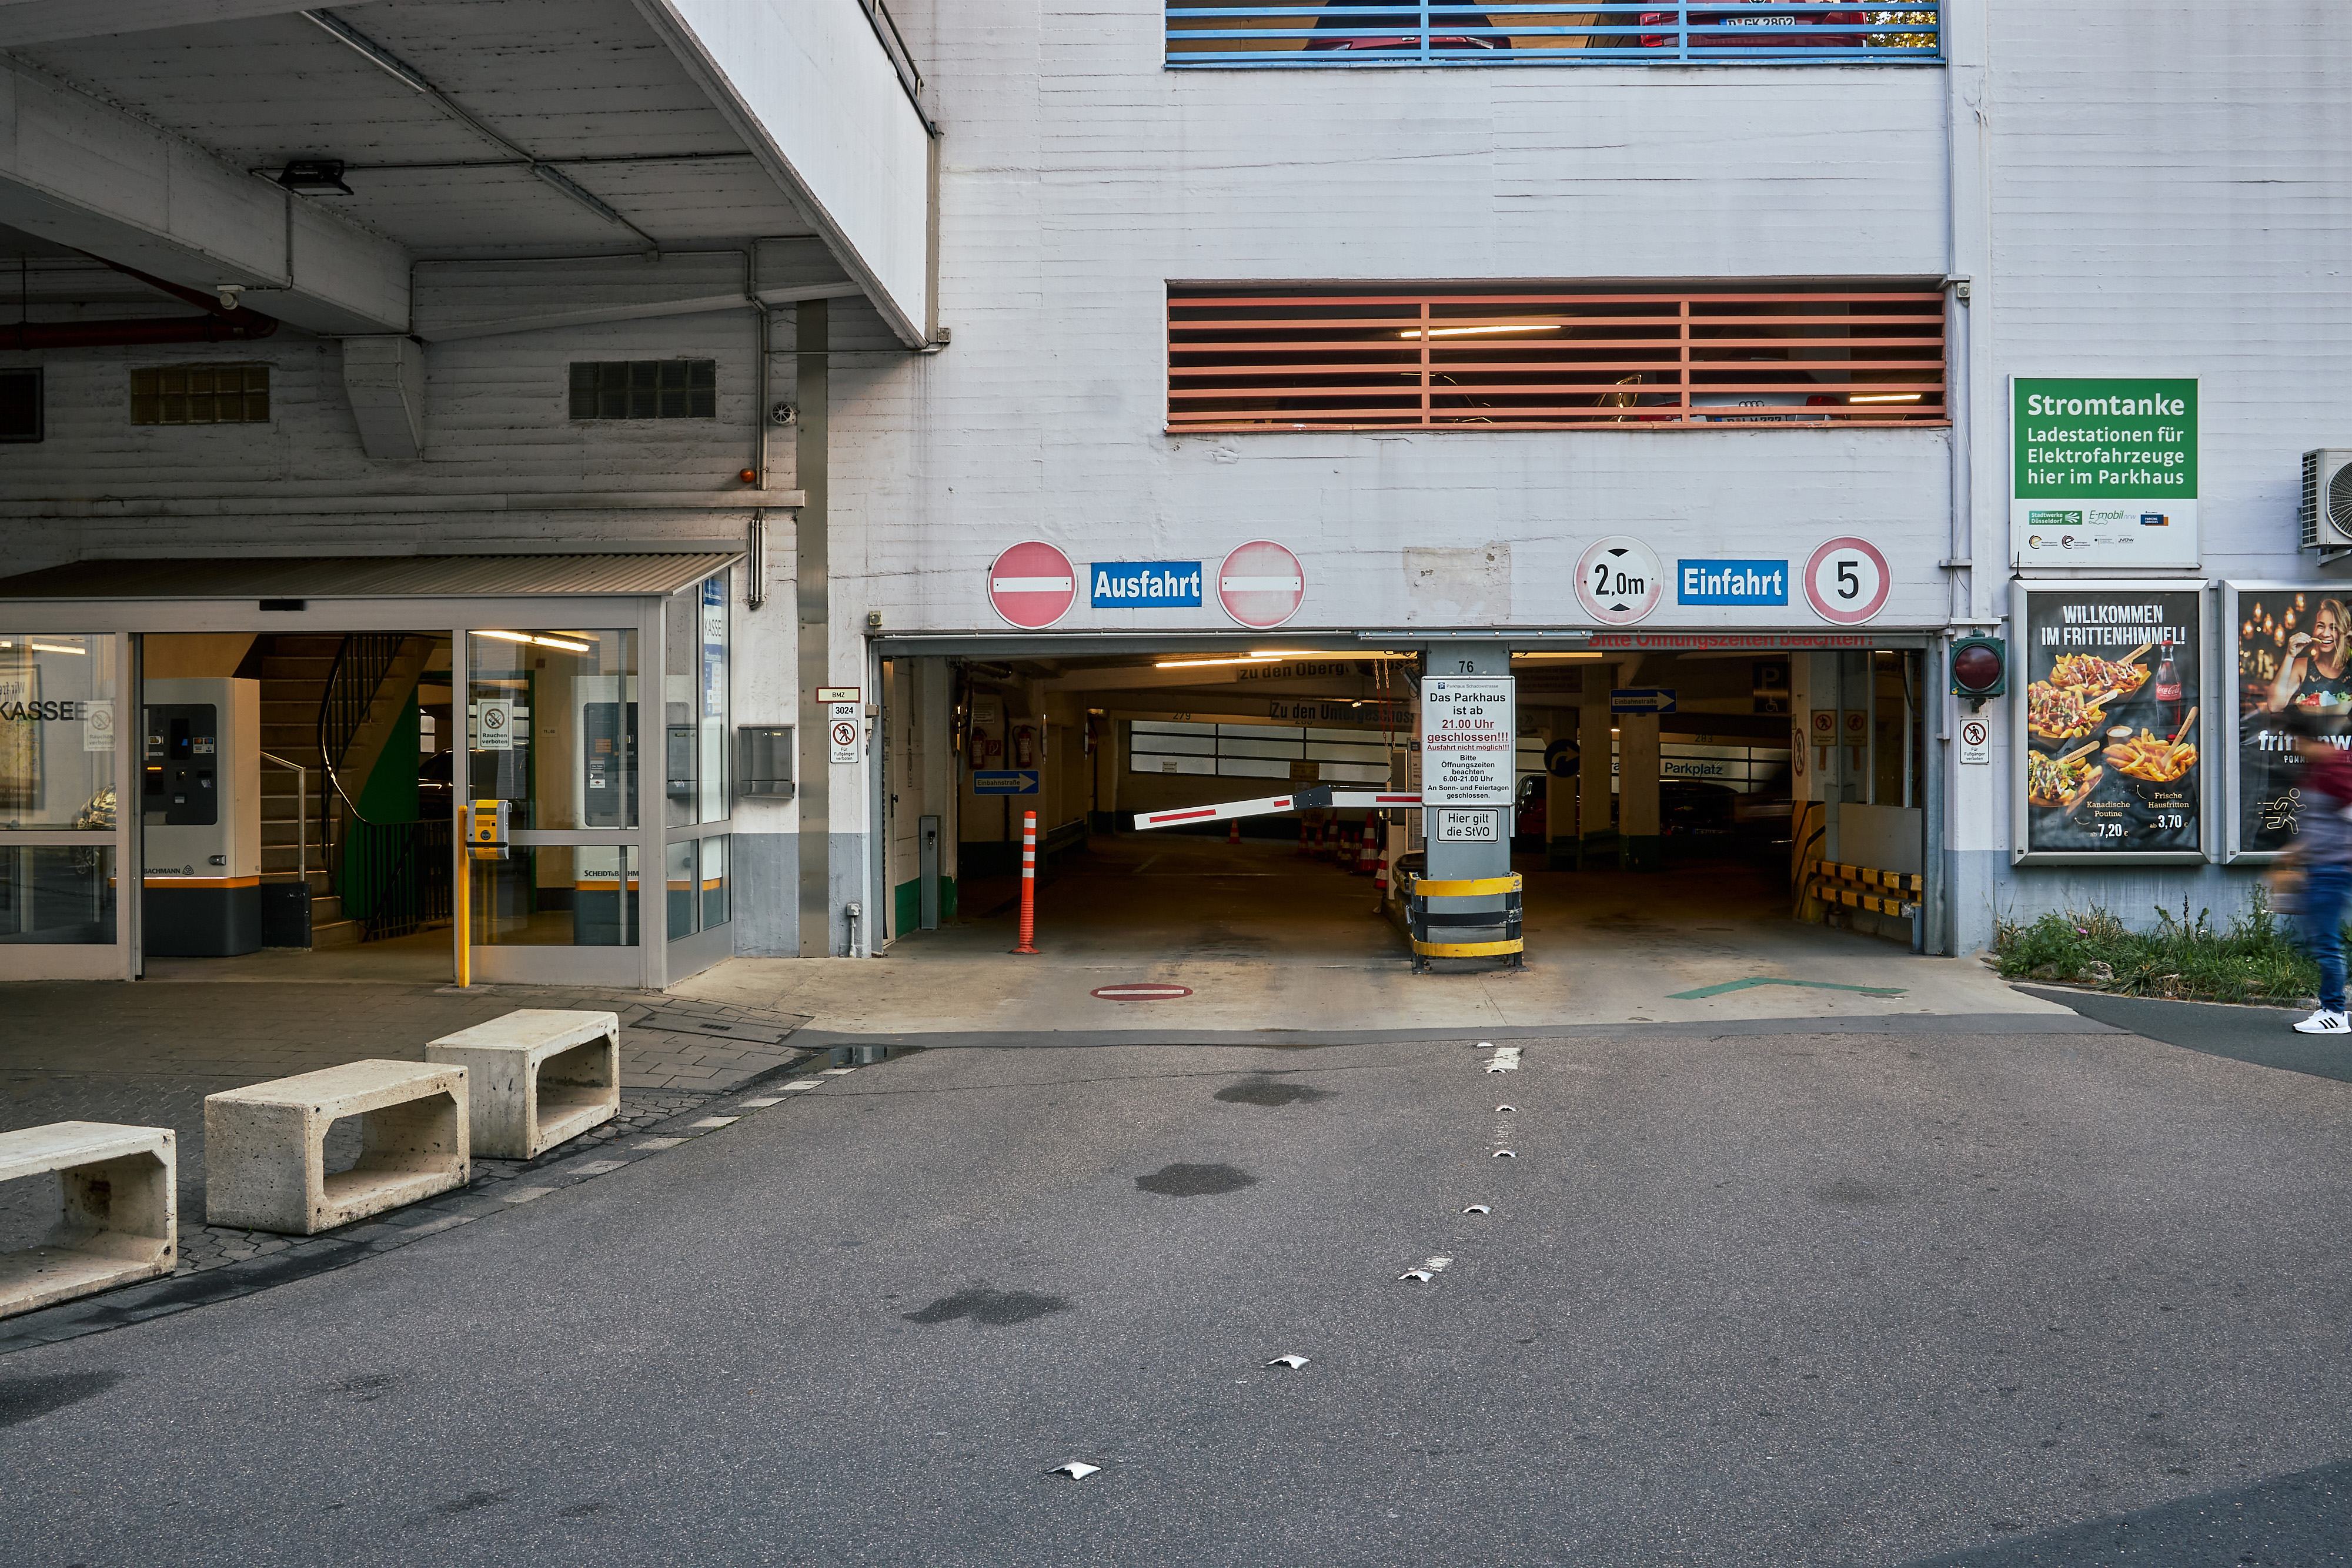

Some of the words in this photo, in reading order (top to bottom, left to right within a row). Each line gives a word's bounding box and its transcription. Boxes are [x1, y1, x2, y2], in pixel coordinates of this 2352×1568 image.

[2027, 393, 2185, 416] Stromtanke
[2027, 426, 2153, 442] Ladestationen
[2157, 426, 2184, 442] für
[2027, 447, 2184, 467] Elektrofahrzeuge
[2027, 469, 2065, 484] hier
[2070, 469, 2092, 484] im
[2099, 469, 2184, 484] Parkhaus
[1094, 570, 1200, 598] Ausfahrt
[1595, 564, 1645, 597] 2,0m
[1683, 568, 1782, 596] Einfahrt
[1838, 561, 1859, 599] 5
[2063, 605, 2163, 624] WILLKOMMEN
[704, 618, 721, 637] KASSE
[1588, 635, 1631, 647] Bitte
[2042, 627, 2060, 646] IM
[2063, 626, 2186, 646] FRITTENHIMMEL!
[1240, 667, 1258, 680] zu
[1262, 664, 1292, 677] den
[1458, 661, 1474, 673] 76
[1430, 693, 1451, 702] Das
[1454, 693, 1506, 702] Parkhaus
[1271, 702, 1287, 718] Zu
[1292, 703, 1315, 720] den
[1453, 706, 1466, 715] ist
[1469, 706, 1483, 715] ab
[1442, 720, 1471, 728] 21.00
[1475, 719, 1495, 728] Uhr
[1427, 732, 1509, 743] geschlossen!!!
[1441, 760, 1495, 769] Öffnungszeiten
[2284, 755, 2309, 763] POMM
[1665, 762, 1723, 777] Parkplatz
[1448, 813, 1470, 823] Hier
[1473, 813, 1489, 825] gilt
[2157, 814, 2183, 830] 3,70
[1446, 827, 1462, 836] die
[1465, 827, 1490, 836] StVO
[2097, 823, 2123, 838] 7,20
